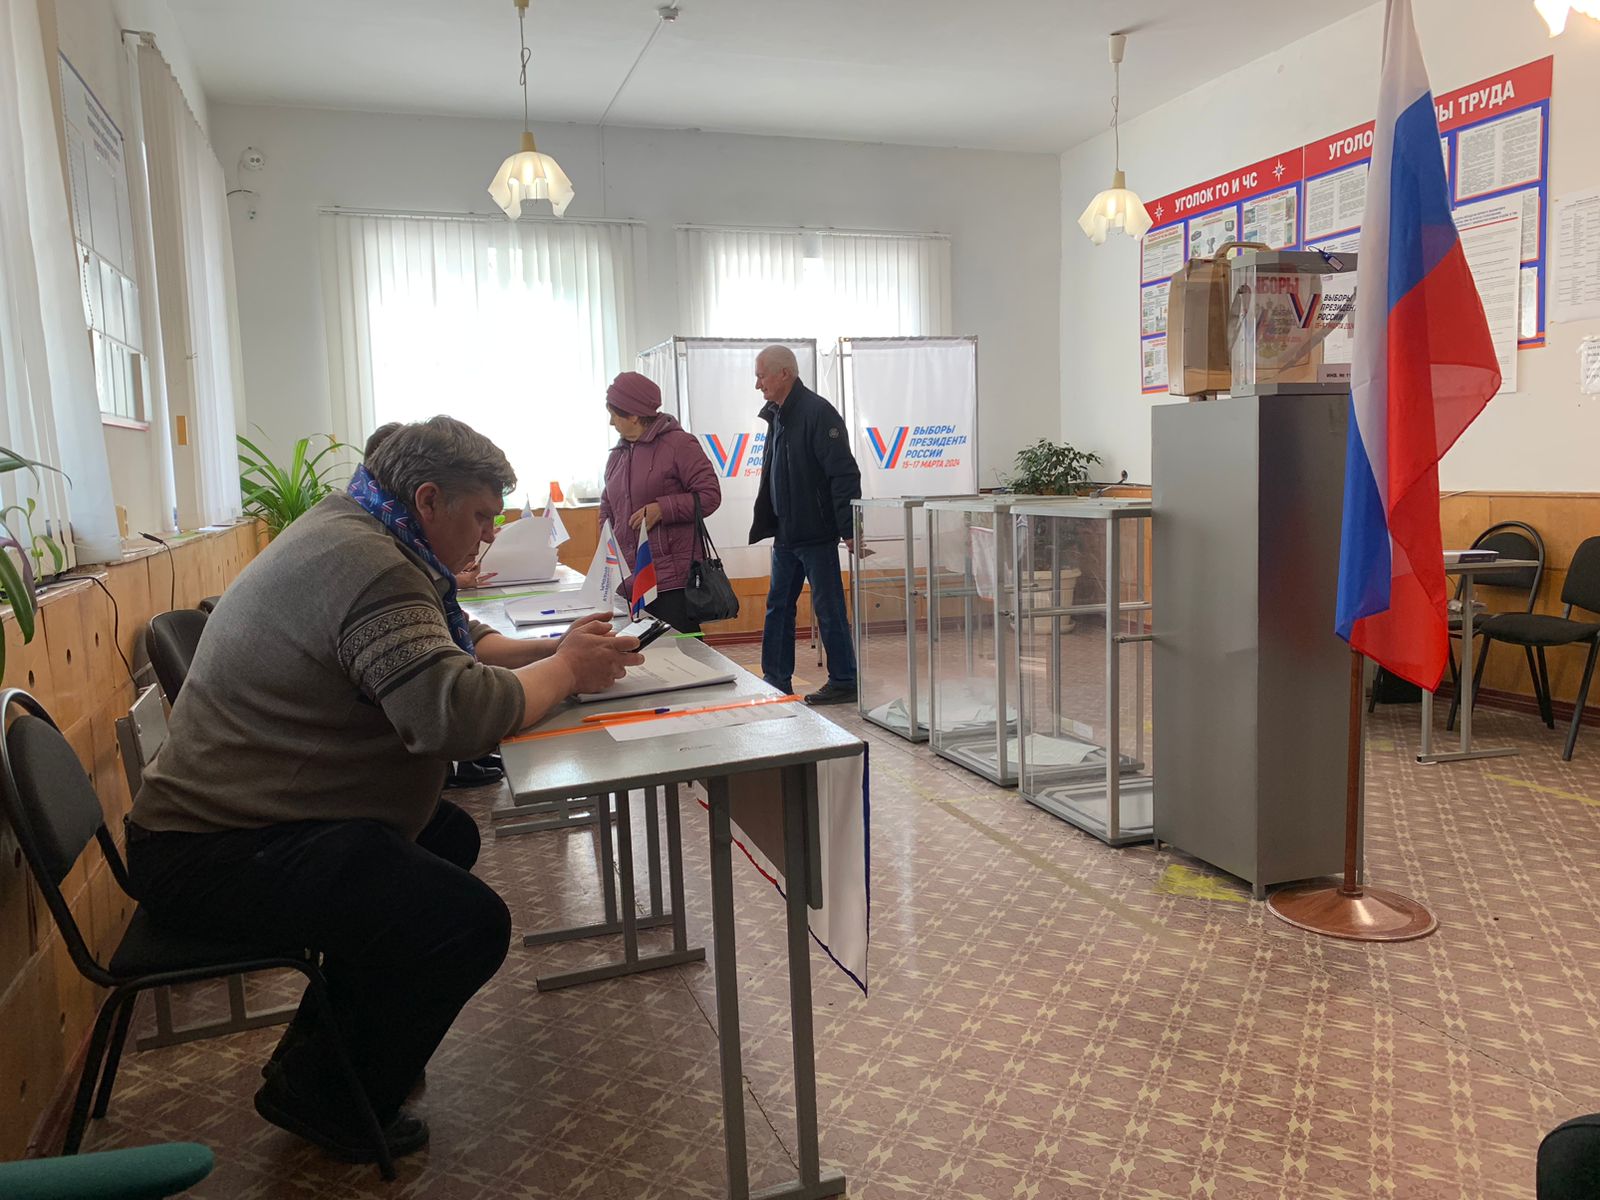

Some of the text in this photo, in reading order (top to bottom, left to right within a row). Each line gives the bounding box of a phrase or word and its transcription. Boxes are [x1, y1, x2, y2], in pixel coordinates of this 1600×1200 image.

[1328, 129, 1374, 161] УГОЛО
[1458, 79, 1516, 116] ТРУДА
[1174, 187, 1214, 213] УГОЛОК
[1215, 181, 1230, 200] ГО
[1232, 177, 1240, 194] И
[1242, 171, 1258, 189] ЧС
[1320, 303, 1356, 312] ПРЕЗИДЕН
[912, 425, 956, 436] ВЫБОРЫ
[908, 435, 968, 448] ПРЕЗИДЕНТА
[905, 448, 944, 459] РОССИИ
[920, 459, 944, 469] МАРТА
[944, 458, 960, 468] 2024
